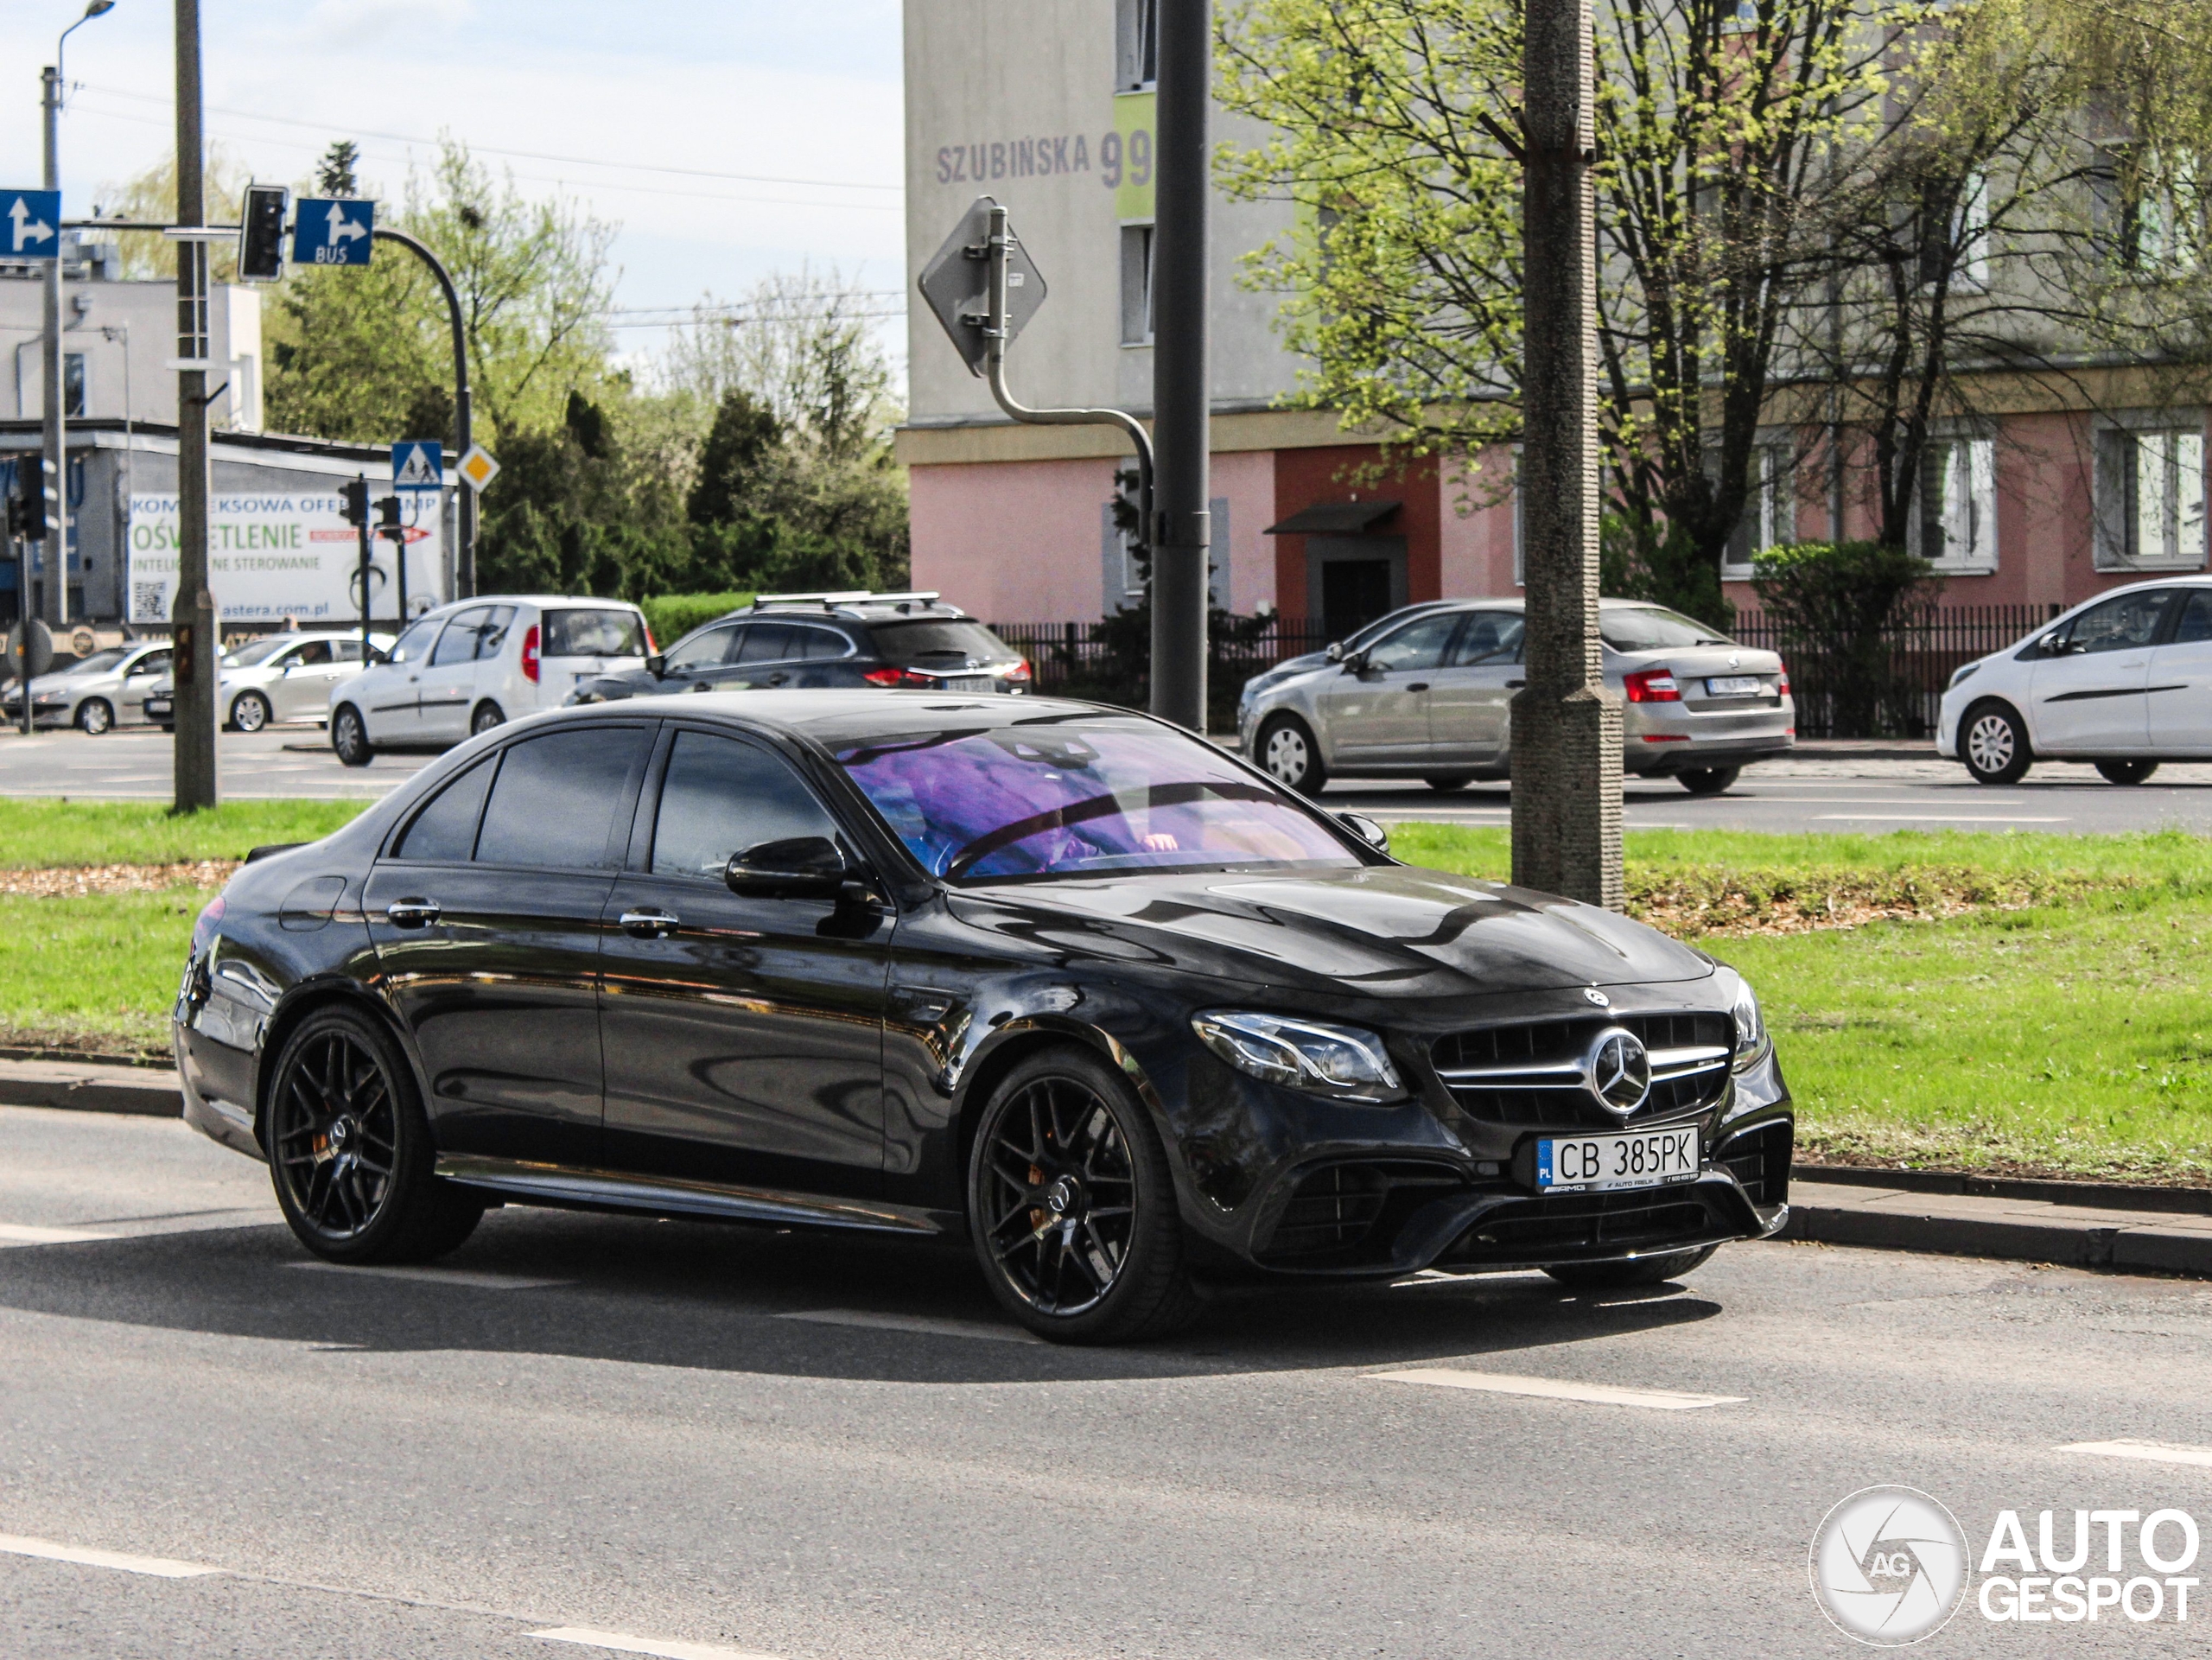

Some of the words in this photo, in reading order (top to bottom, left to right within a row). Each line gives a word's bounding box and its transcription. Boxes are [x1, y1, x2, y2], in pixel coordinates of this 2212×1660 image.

[936, 133, 1090, 184] SZUBIŃSKA
[1100, 129, 1152, 189] 99
[315, 245, 347, 264] BUS
[133, 499, 293, 514] KOMEKSOWA
[134, 518, 302, 550] OŚWTLENIE
[234, 557, 321, 571] STEROWANIE
[1560, 1142, 1599, 1179] CB
[1614, 1133, 1691, 1176] 385PK
[1540, 1167, 1551, 1179] PL
[1558, 1184, 1586, 1193] AMG
